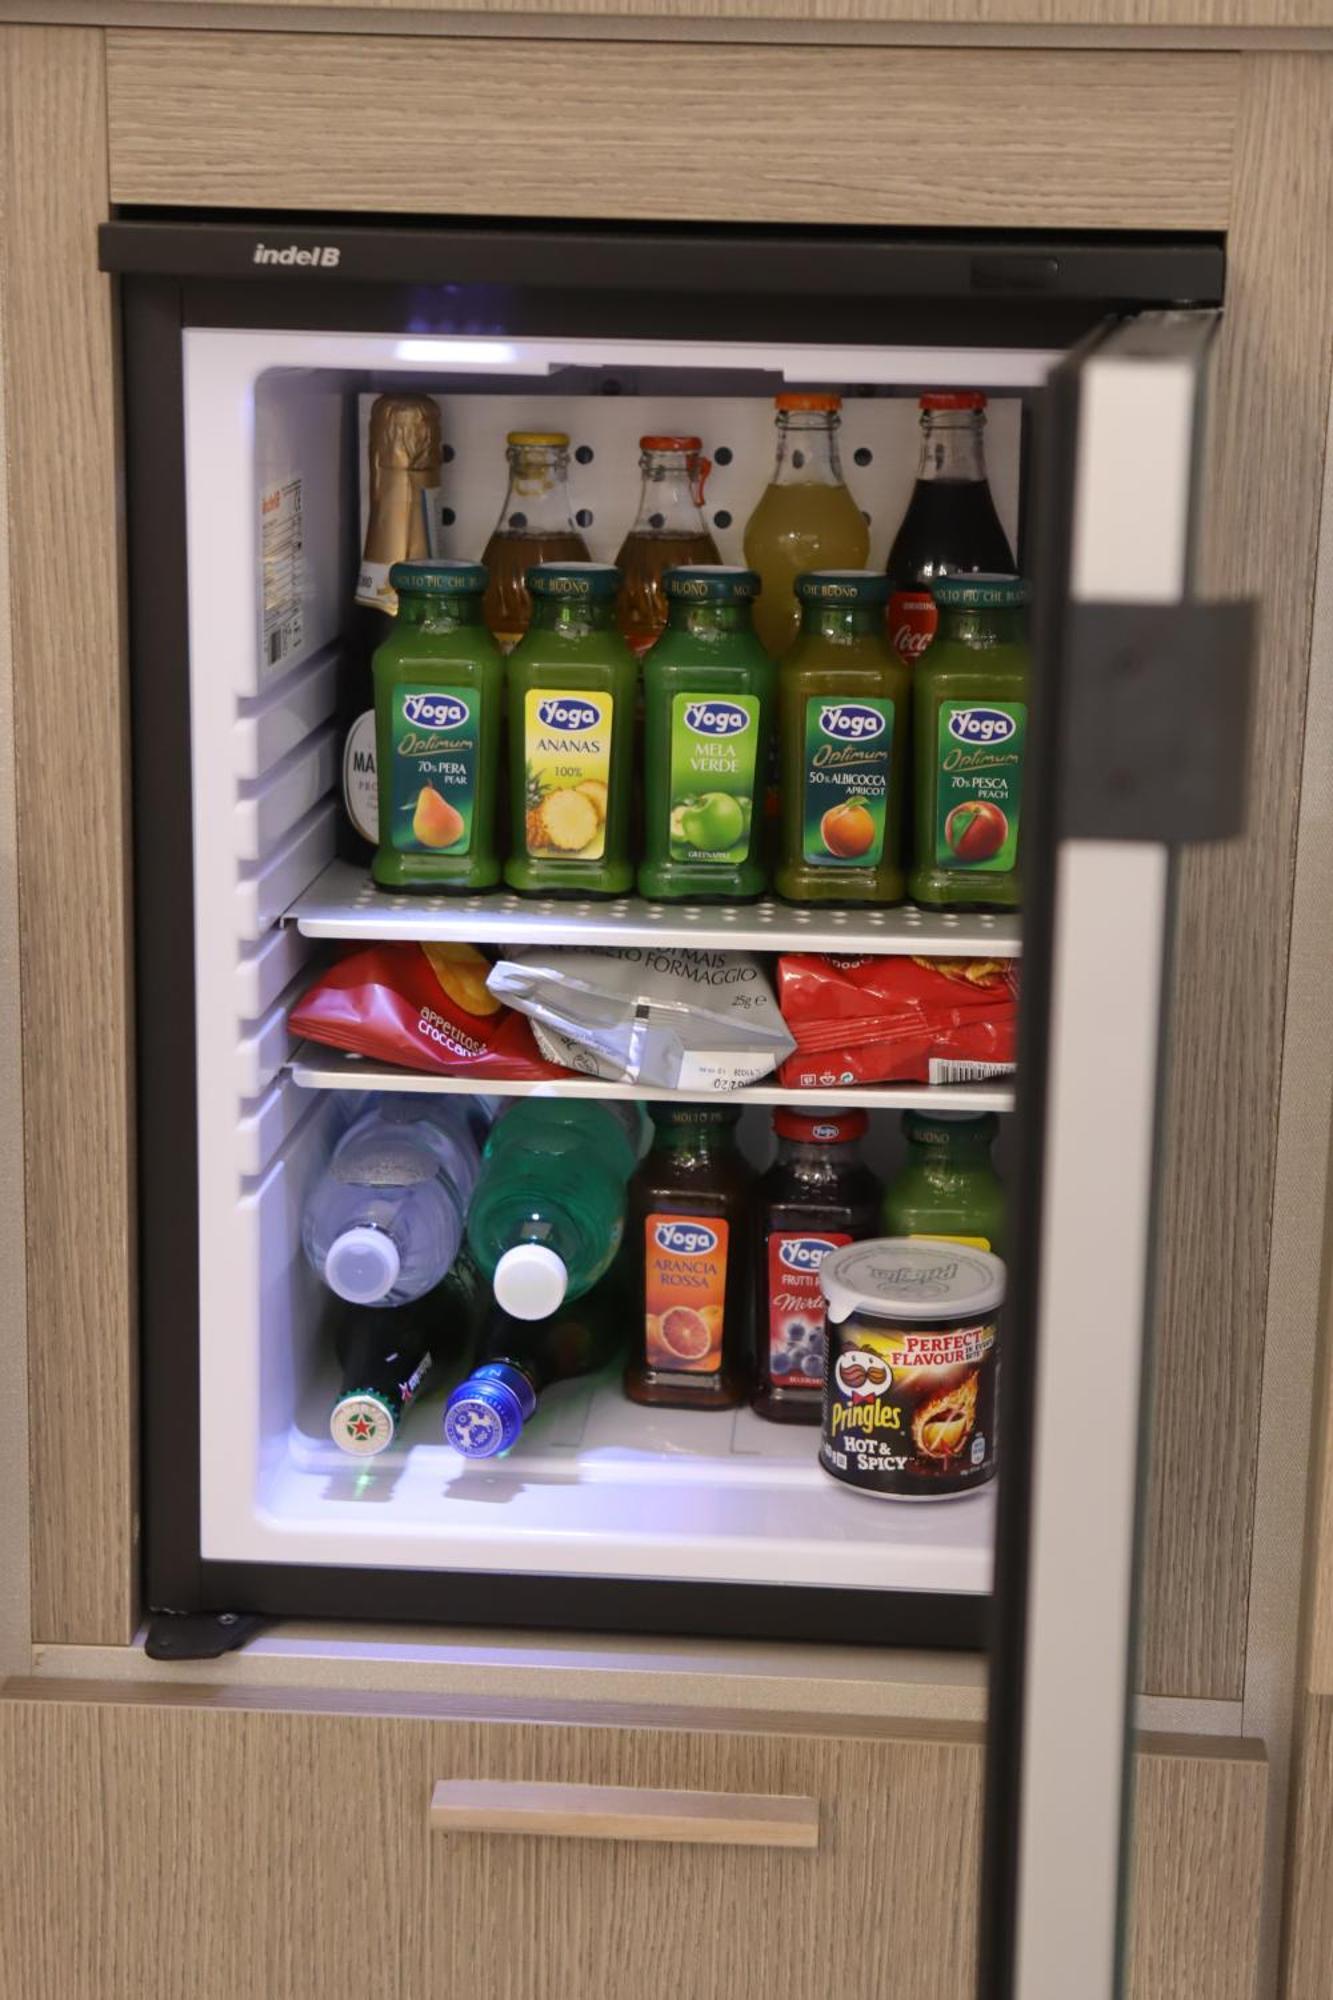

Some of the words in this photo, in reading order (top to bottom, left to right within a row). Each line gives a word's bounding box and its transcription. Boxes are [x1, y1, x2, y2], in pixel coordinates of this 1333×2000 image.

[549, 579, 589, 592] BUONO
[822, 585, 858, 598] BUONO
[894, 624, 933, 651] Coca
[404, 694, 462, 725] Yoga
[541, 700, 595, 729] Yoga
[687, 702, 743, 733] Yoga
[821, 705, 878, 737] Yoga
[951, 710, 1008, 740] Yoga
[398, 732, 473, 756] Optimum
[539, 739, 600, 753] ANANAS
[695, 743, 737, 758] MELA
[690, 757, 738, 773] VERDE
[812, 744, 888, 768] Optimum
[943, 748, 1019, 771] Optimum
[438, 762, 467, 774] PERA
[554, 766, 583, 777] 100%
[444, 775, 468, 785] PEAR
[831, 773, 887, 786] ALBICOCCA
[971, 776, 1009, 789] PESCA
[846, 786, 885, 796] APRICOT
[978, 789, 1009, 799] PEACH
[680, 948, 726, 969] MAIS
[644, 955, 757, 986] FORMAGGIO
[420, 1006, 487, 1054] appetitos
[656, 1222, 710, 1251] Yoga
[781, 1239, 831, 1268] Yog
[656, 1259, 718, 1276] ARANCIA
[659, 1272, 709, 1289] ROSSA
[781, 1274, 814, 1287] FRUTTI
[906, 1330, 982, 1353] PERFECT
[892, 1350, 965, 1366] FLAVOUR
[831, 1399, 902, 1438] Pringles
[843, 1435, 878, 1454] HOT
[878, 1442, 892, 1456] &
[856, 1453, 908, 1471] SPICY
